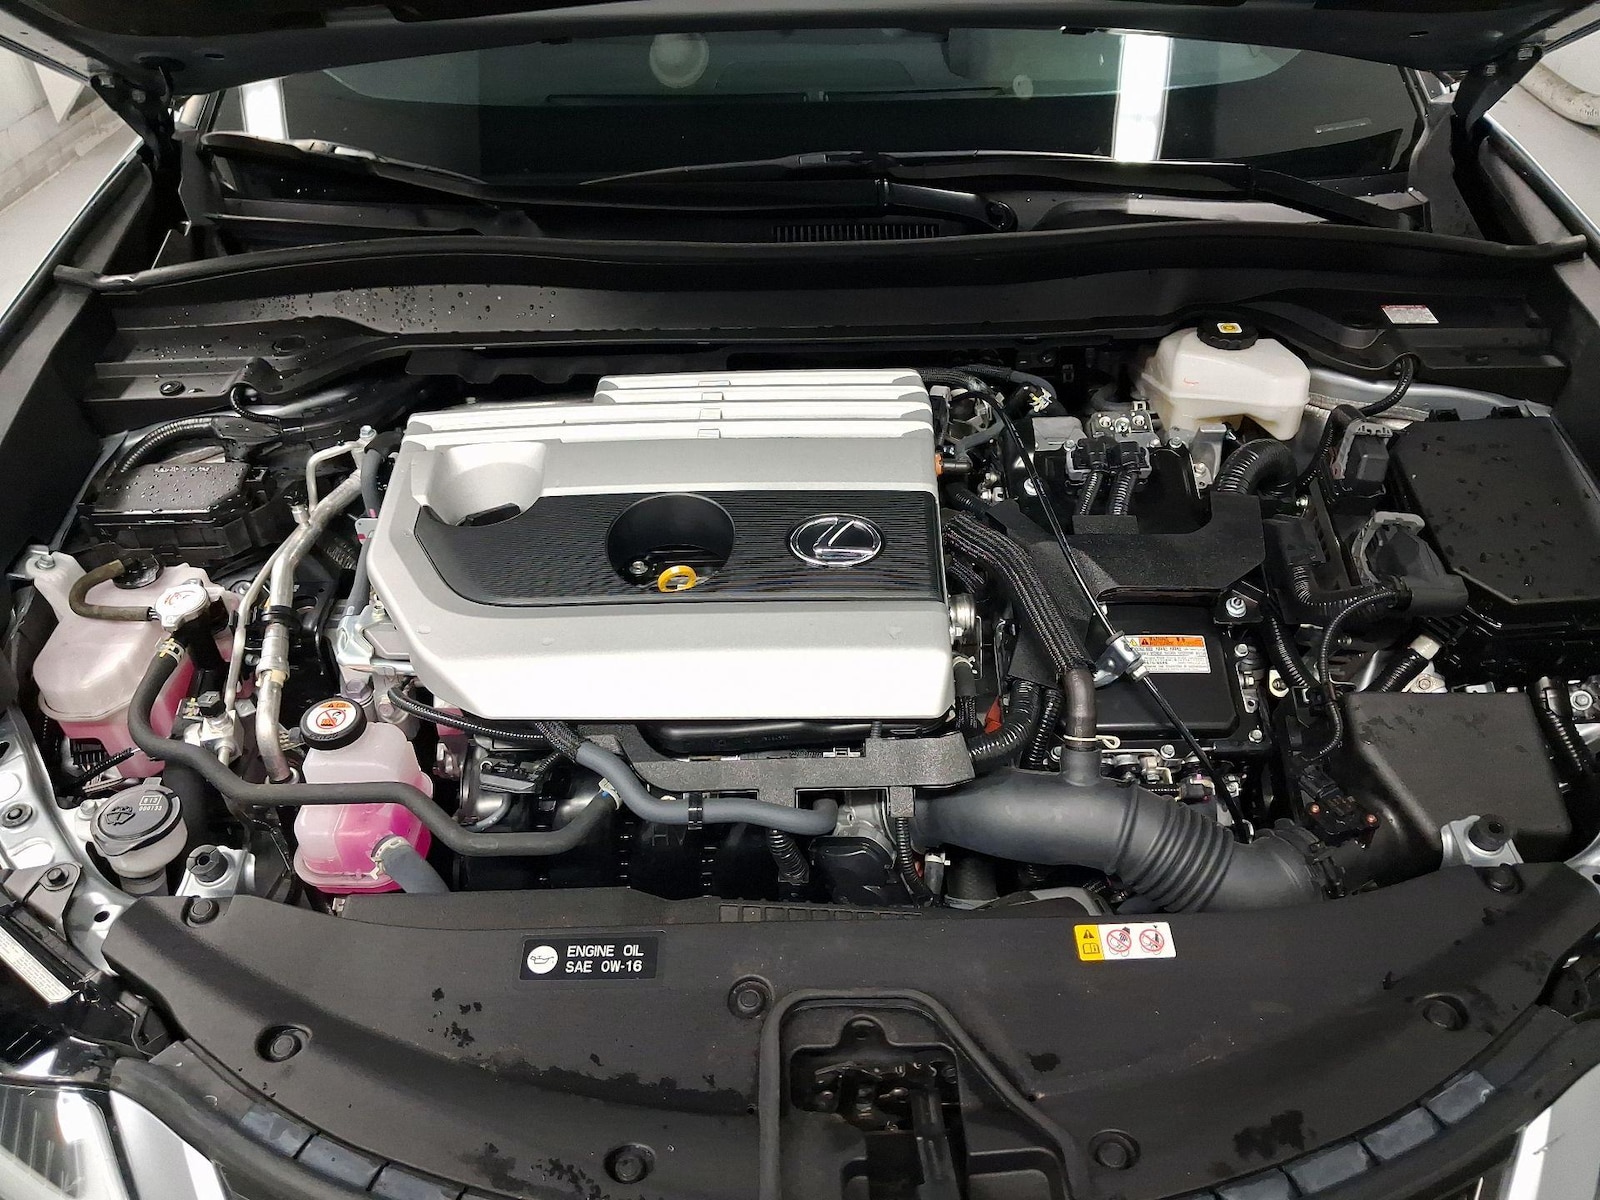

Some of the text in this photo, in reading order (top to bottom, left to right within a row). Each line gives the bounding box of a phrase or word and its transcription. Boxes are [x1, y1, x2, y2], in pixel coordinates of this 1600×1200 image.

[566, 944, 645, 958] ENGINE OIL
[565, 960, 643, 973] SAE 0W-16
